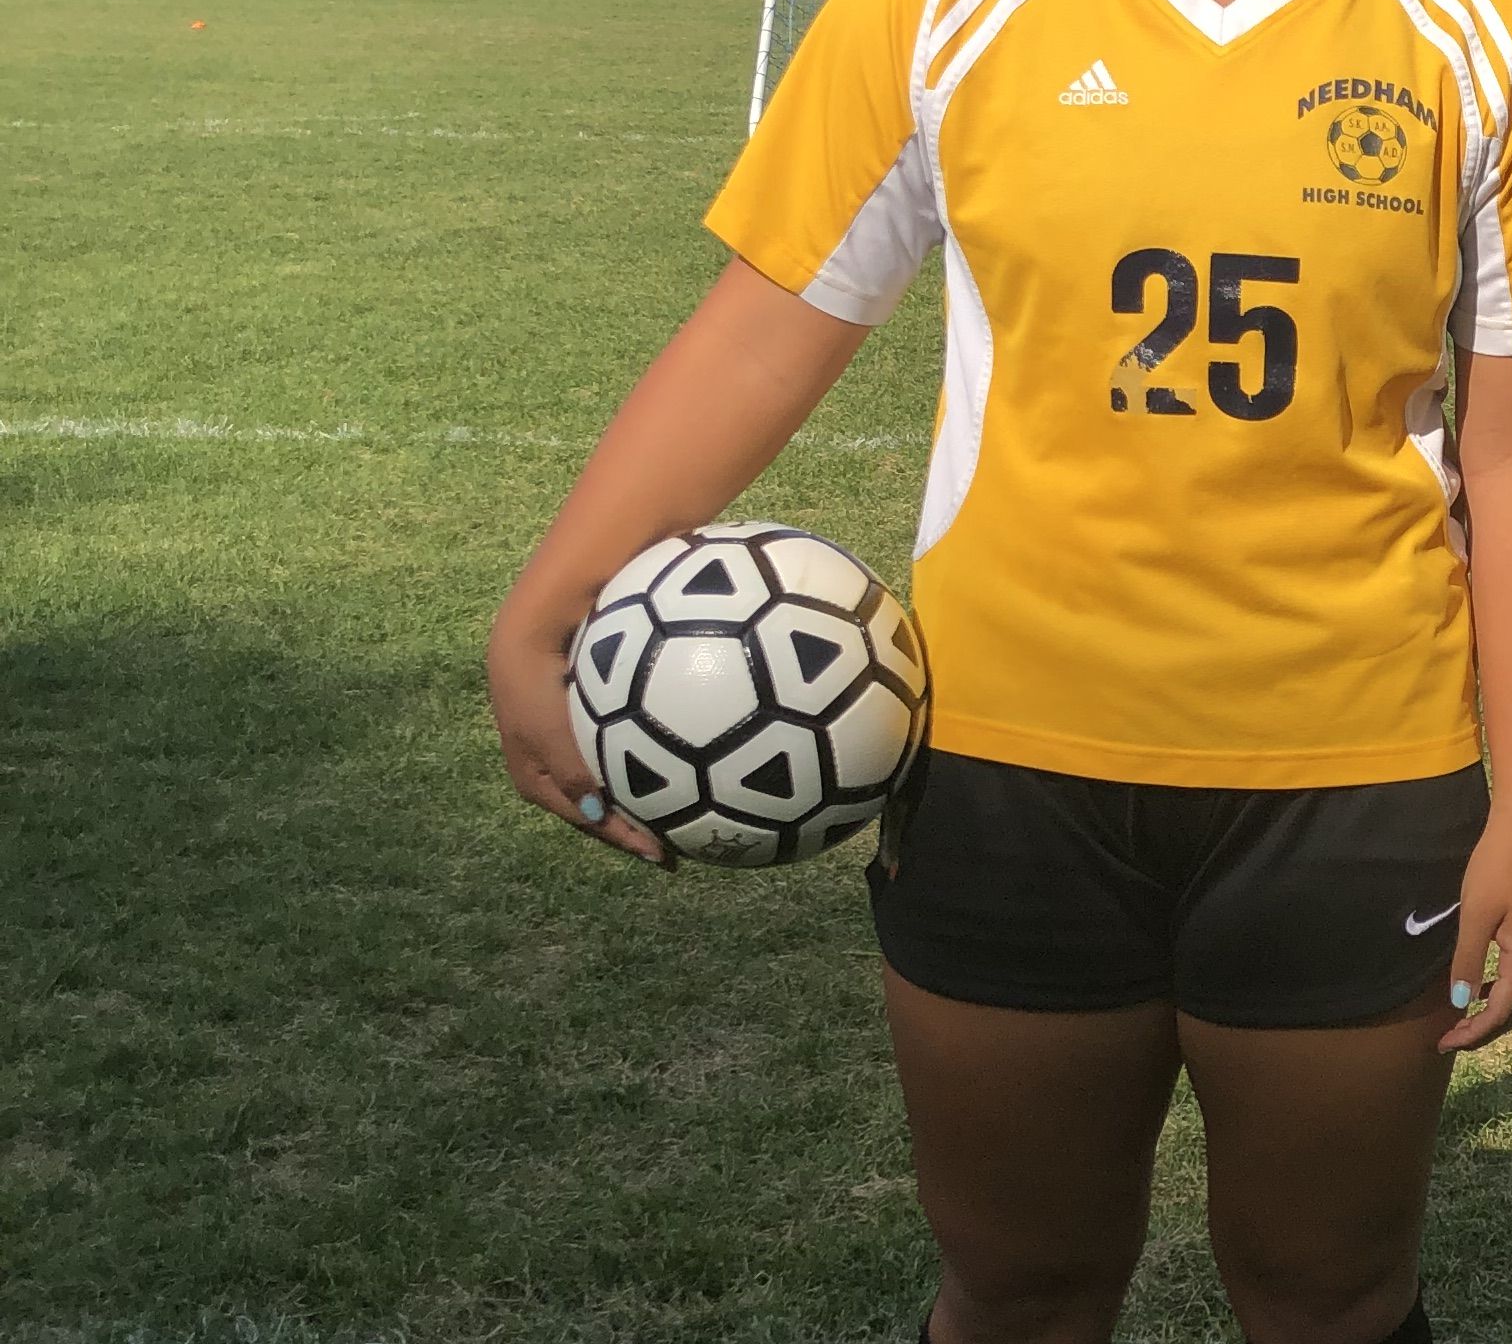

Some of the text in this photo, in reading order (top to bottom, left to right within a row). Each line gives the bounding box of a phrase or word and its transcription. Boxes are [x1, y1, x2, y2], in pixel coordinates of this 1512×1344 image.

[1059, 87, 1129, 106] adidas
[1298, 78, 1438, 133] NEEDHAM
[1302, 187, 1425, 216] HIGH SCHOOL
[1111, 248, 1300, 422] 25
